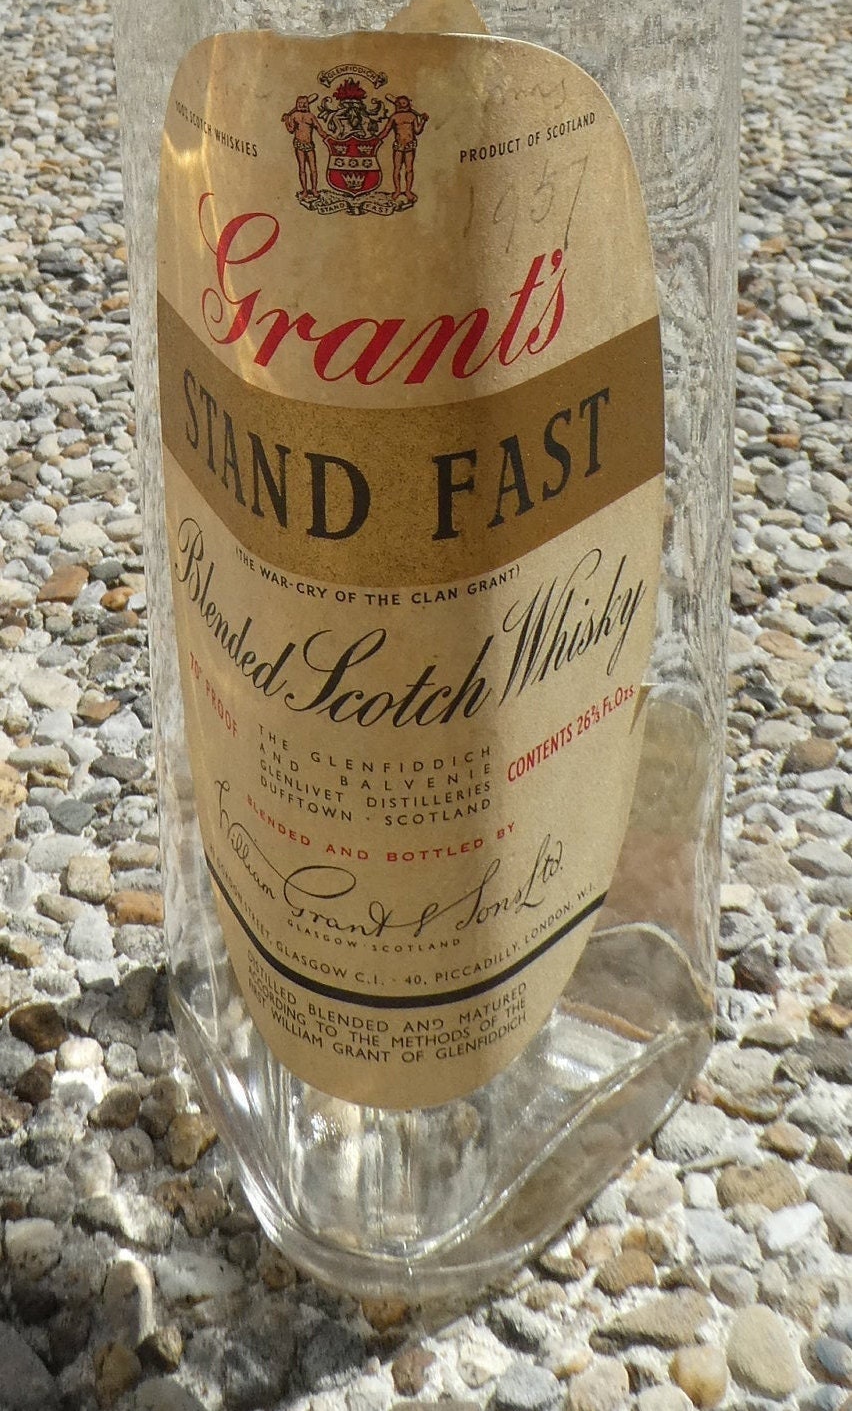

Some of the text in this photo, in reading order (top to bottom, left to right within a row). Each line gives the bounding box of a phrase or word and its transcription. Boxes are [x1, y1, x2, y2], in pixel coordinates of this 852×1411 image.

[327, 66, 376, 80] GLENFIDDICH
[190, 110, 212, 137] SCOTCH
[214, 128, 258, 157] WHISKIES
[460, 112, 596, 163] PRODUCT OF SCOTLAND
[319, 202, 390, 214] STAND FAST
[198, 193, 566, 385] Grant's
[183, 369, 611, 541] STAND FAST
[259, 565, 328, 598] WAR-CRY
[335, 590, 356, 604] OF
[364, 593, 401, 606] THE
[411, 587, 458, 604] CLAN
[467, 564, 521, 595] GRANT)
[175, 517, 646, 728] Blended Scotch Whisky
[206, 679, 237, 737] PROOF
[258, 723, 491, 773] THE GLENFIDDICH
[259, 742, 491, 791] AND BALVENIE
[507, 723, 573, 782] CONTENTS
[260, 759, 491, 808] GLENLIVET DISTILLERIES
[260, 775, 491, 826] DUFFTOWN SCOTLAND
[247, 794, 515, 863] BLENDED AND BOTTLED BY
[283, 865, 393, 937] Grant
[455, 858, 523, 931] Sons
[276, 940, 348, 979] GLASGOW
[287, 918, 460, 953] GLASGOW SCOTLAND
[308, 1002, 389, 1033] BLENDED
[403, 1018, 444, 1033] AND
[459, 982, 527, 1024] MATURED
[316, 1021, 338, 1037] TO
[350, 1030, 380, 1047] THE
[391, 1027, 470, 1048] METHODS
[480, 1015, 498, 1033] OF
[506, 998, 526, 1019] THE
[270, 1006, 323, 1048] WILLIAM
[333, 1042, 391, 1063] GRANT
[401, 1050, 424, 1064] OF
[435, 1011, 527, 1060] GLENFIDDICH
